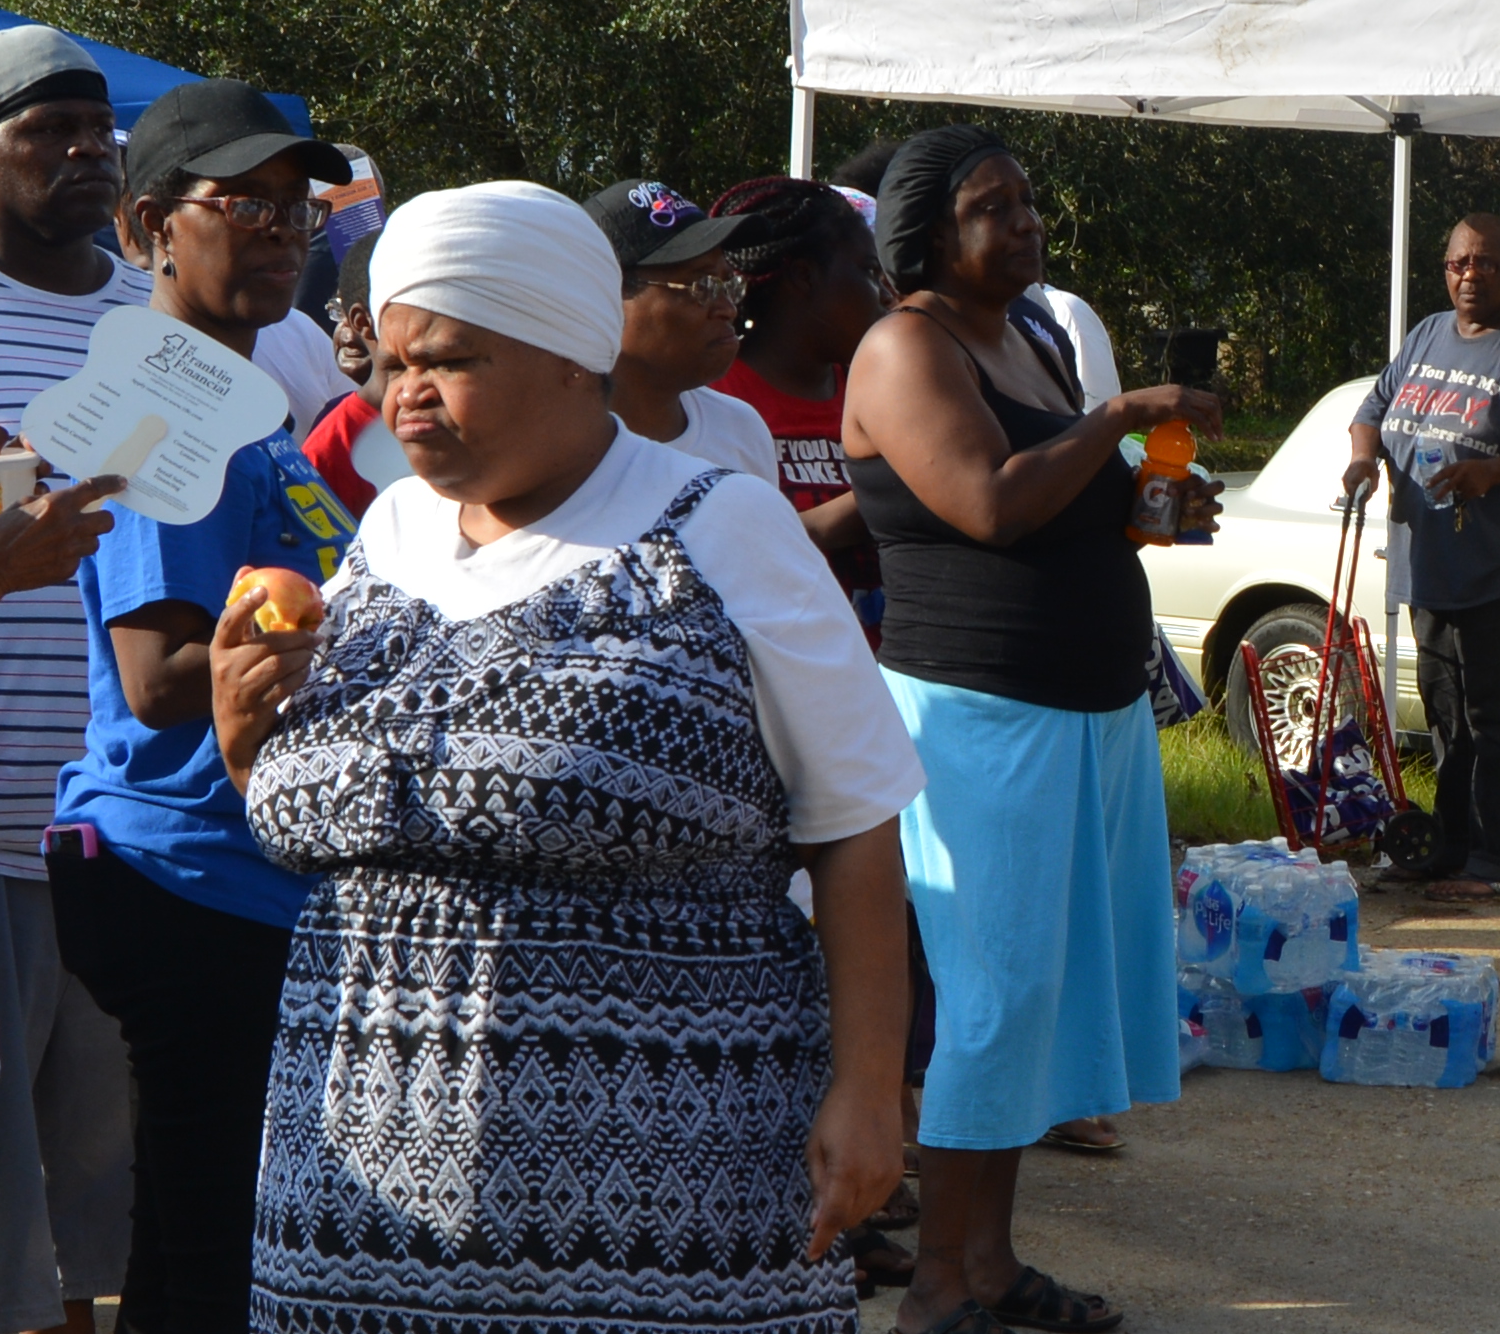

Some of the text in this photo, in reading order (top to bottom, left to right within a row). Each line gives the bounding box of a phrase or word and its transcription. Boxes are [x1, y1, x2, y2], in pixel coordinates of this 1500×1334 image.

[173, 359, 231, 397] Financial
[180, 349, 233, 386] Franklin
[1420, 364, 1446, 380] You
[1447, 369, 1477, 385] Met
[89, 393, 110, 408] Georgia
[98, 381, 121, 397] Alabama
[67, 412, 97, 433] Mississippi
[77, 402, 104, 420] Louisiana
[53, 420, 92, 447] South Carolina
[173, 439, 211, 463] Consolidation
[179, 450, 196, 463] Loans
[201, 440, 218, 453] Loans
[787, 439, 830, 462] YOU
[159, 453, 200, 480] Personal Loans
[782, 462, 843, 485] LIKE
[1143, 481, 1168, 507] G
[1209, 910, 1232, 934] Life
